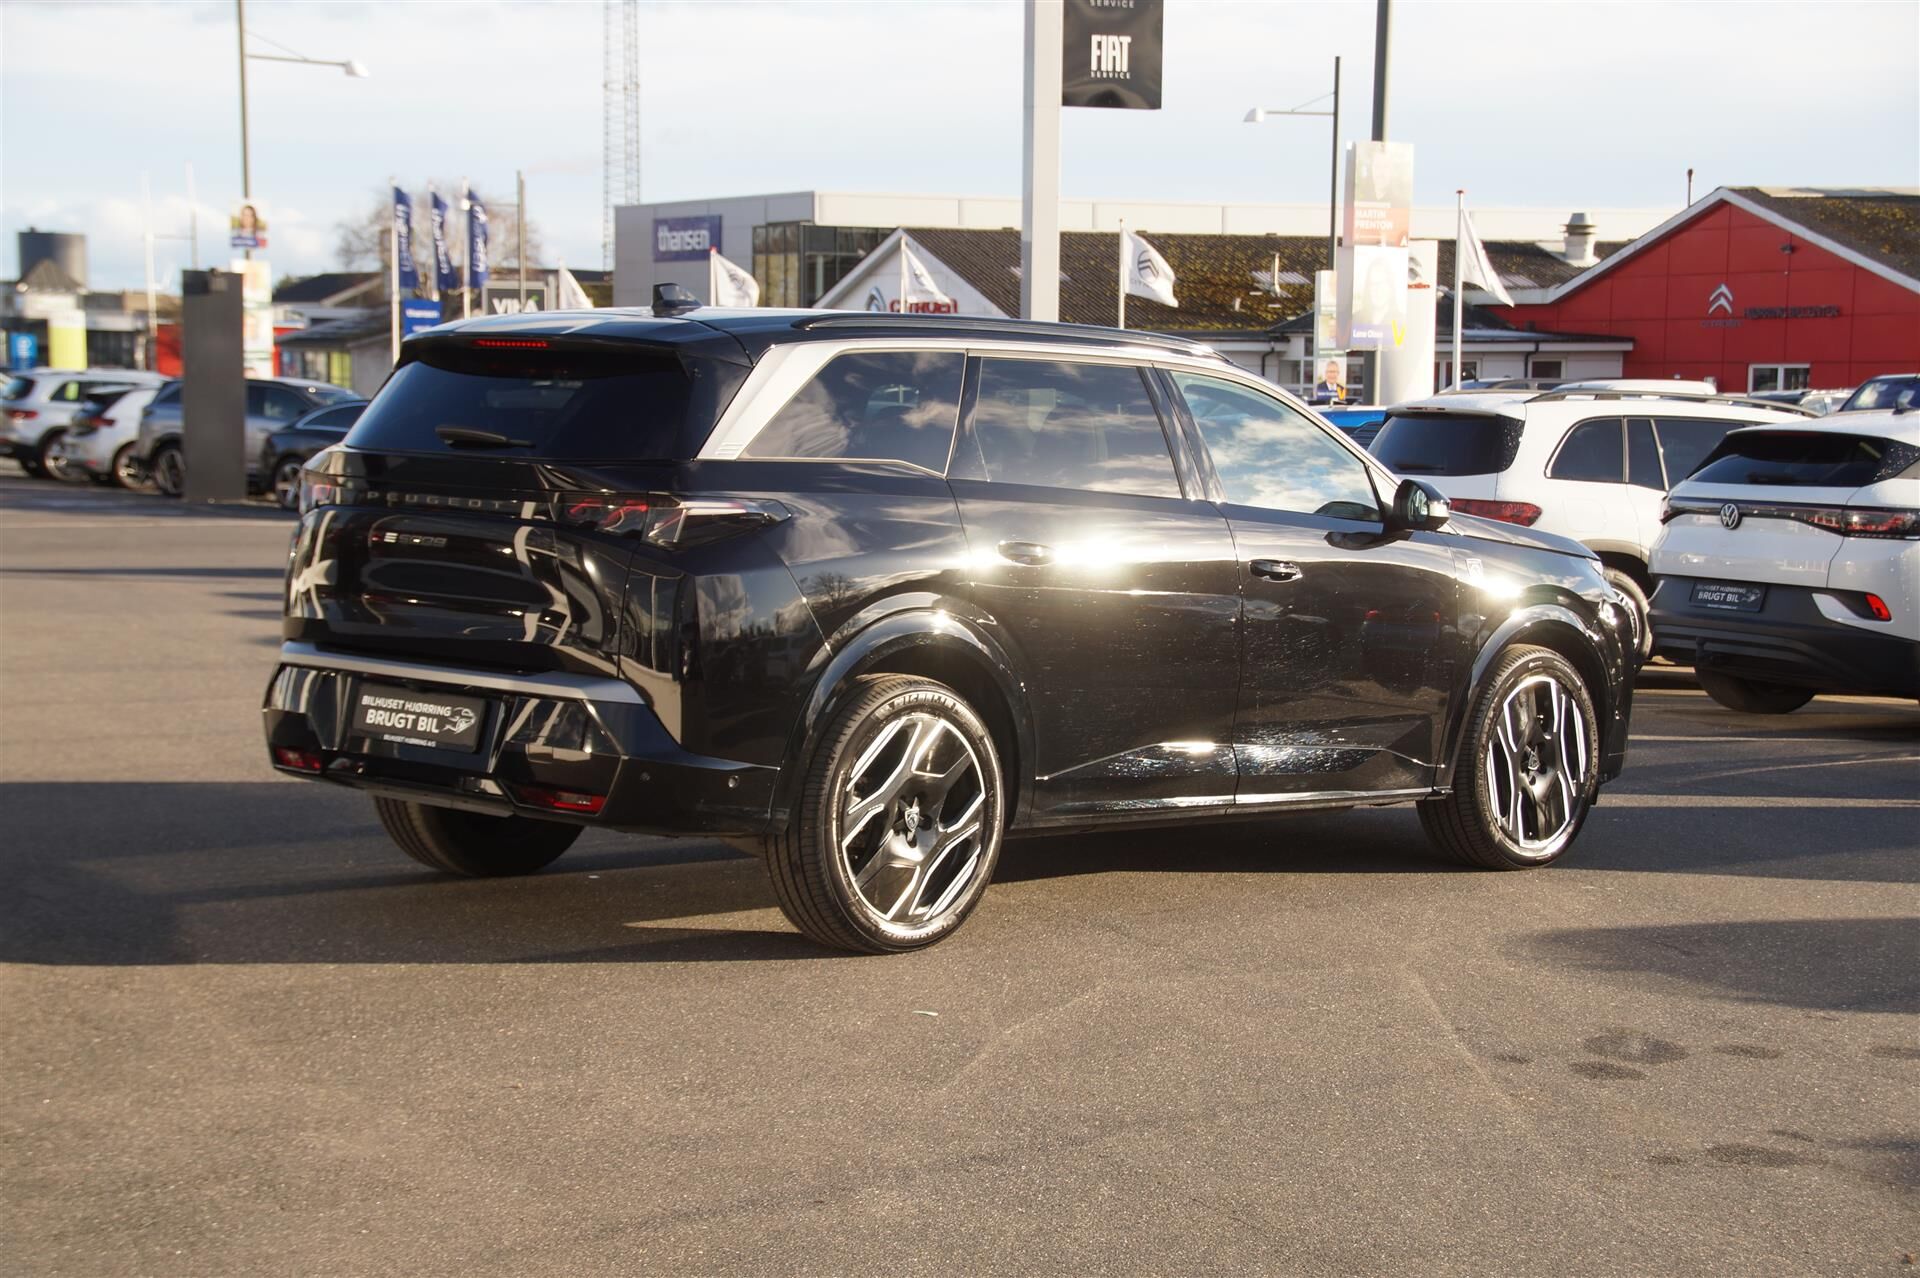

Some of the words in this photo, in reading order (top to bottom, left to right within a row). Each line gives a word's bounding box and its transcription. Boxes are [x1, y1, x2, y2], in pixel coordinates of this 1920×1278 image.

[1090, 34, 1132, 72] FIAT
[1090, 71, 1131, 79] SERVICE
[657, 225, 710, 252] thansen
[367, 491, 503, 509] PEUGEOT
[1697, 591, 1726, 601] BRUGT
[1726, 593, 1739, 602] BIL
[361, 695, 405, 710] BILHUSET
[405, 701, 452, 717] HJØRRING
[365, 709, 416, 729] BRUGT
[417, 716, 440, 733] BIL
